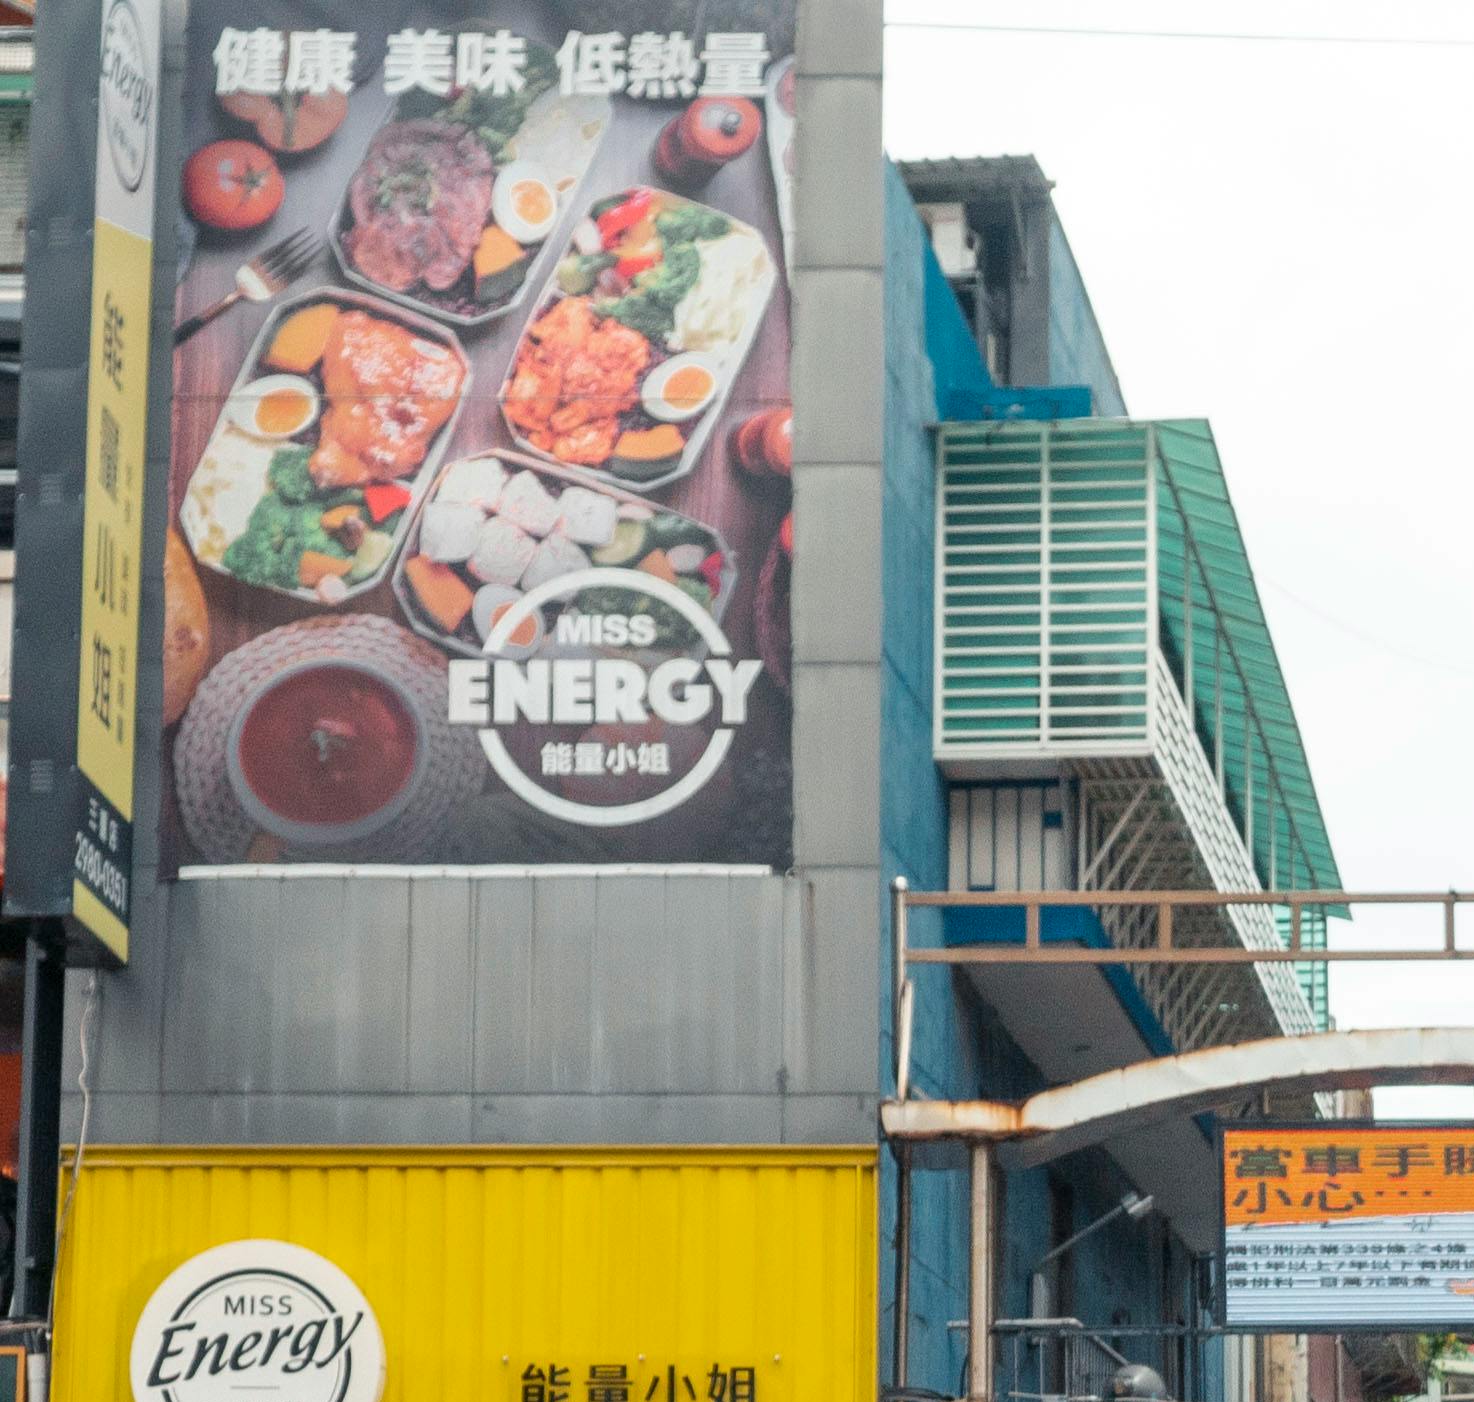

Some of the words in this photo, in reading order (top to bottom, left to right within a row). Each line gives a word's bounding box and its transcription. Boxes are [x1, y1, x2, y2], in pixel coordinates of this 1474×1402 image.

[212, 28, 353, 96] 健康
[384, 30, 527, 97] 美味
[556, 31, 772, 99] 低熱量
[557, 613, 655, 649] MISS
[448, 659, 764, 726] ENERGY
[541, 742, 670, 776] 能量小姐
[224, 1294, 292, 1317] MISS
[146, 1309, 364, 1389] Energy
